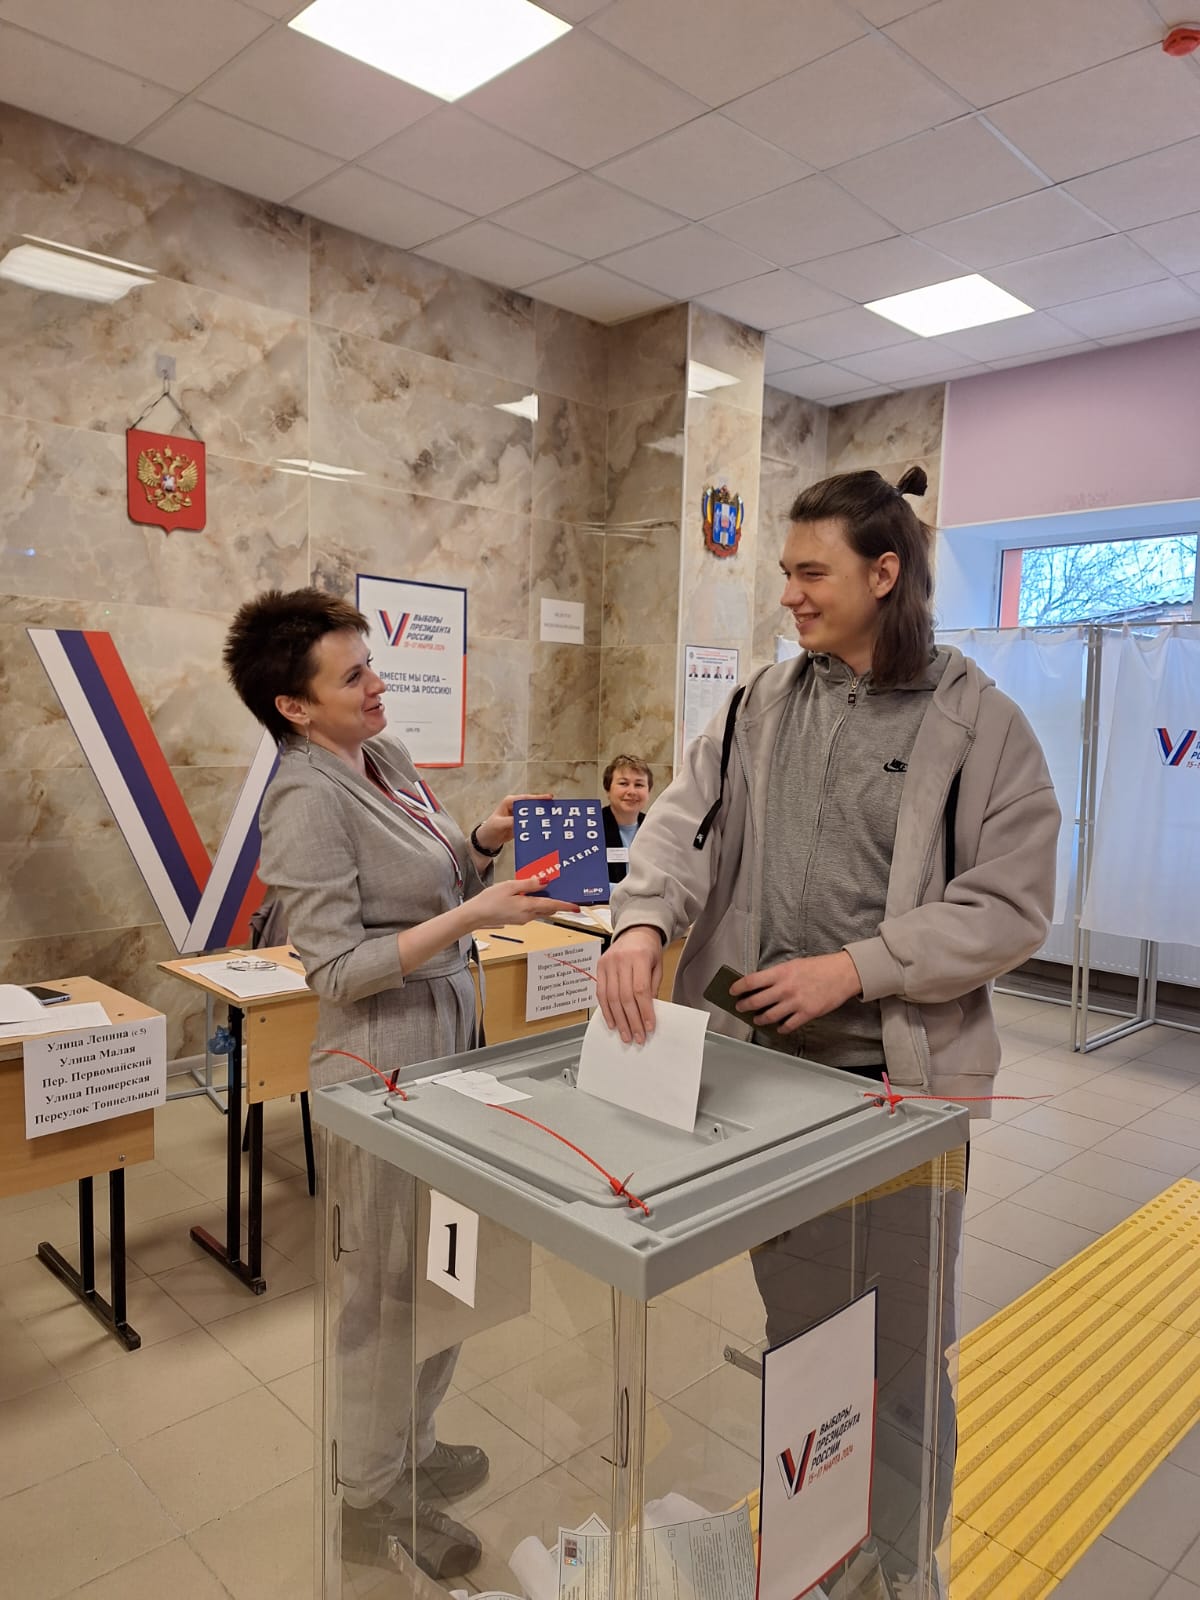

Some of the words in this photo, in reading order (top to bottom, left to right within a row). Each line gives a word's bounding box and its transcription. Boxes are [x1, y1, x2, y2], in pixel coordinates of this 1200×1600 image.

[409, 623, 451, 634] ПРЕЗИДЕНТА
[413, 614, 444, 624] ВЫБОРЫ
[406, 632, 433, 641] РОССИИ
[379, 671, 407, 681] ВМЕСТЕ
[408, 673, 421, 682] МЫ
[423, 673, 441, 683] СИЛА
[384, 683, 410, 693] ОСУЕМ
[411, 684, 420, 693] ЗА
[421, 685, 452, 695] РОССИЮ!
[518, 806, 596, 817] СВИДЕ
[518, 818, 597, 829] ТЕЛЬ
[519, 830, 598, 842] СТВО
[531, 845, 600, 880] БИРАТЕЛЯ
[47, 1040, 84, 1053] Улица
[86, 1029, 129, 1045] Ленина
[59, 1054, 96, 1068] Улица
[99, 1044, 136, 1059] Малая
[42, 1077, 68, 1089] Пер.
[71, 1056, 152, 1083] Первомайский
[45, 1091, 82, 1105] Улица
[85, 1074, 150, 1096] Пионерская
[34, 1106, 90, 1125] Переулок
[91, 1086, 160, 1111] Тоннельный
[442, 1222, 460, 1281] 1
[819, 1404, 852, 1436] ВЫБОРЫ
[815, 1412, 861, 1453] ПРЕЗИДЕНТА
[811, 1440, 841, 1471] РОССИИ
